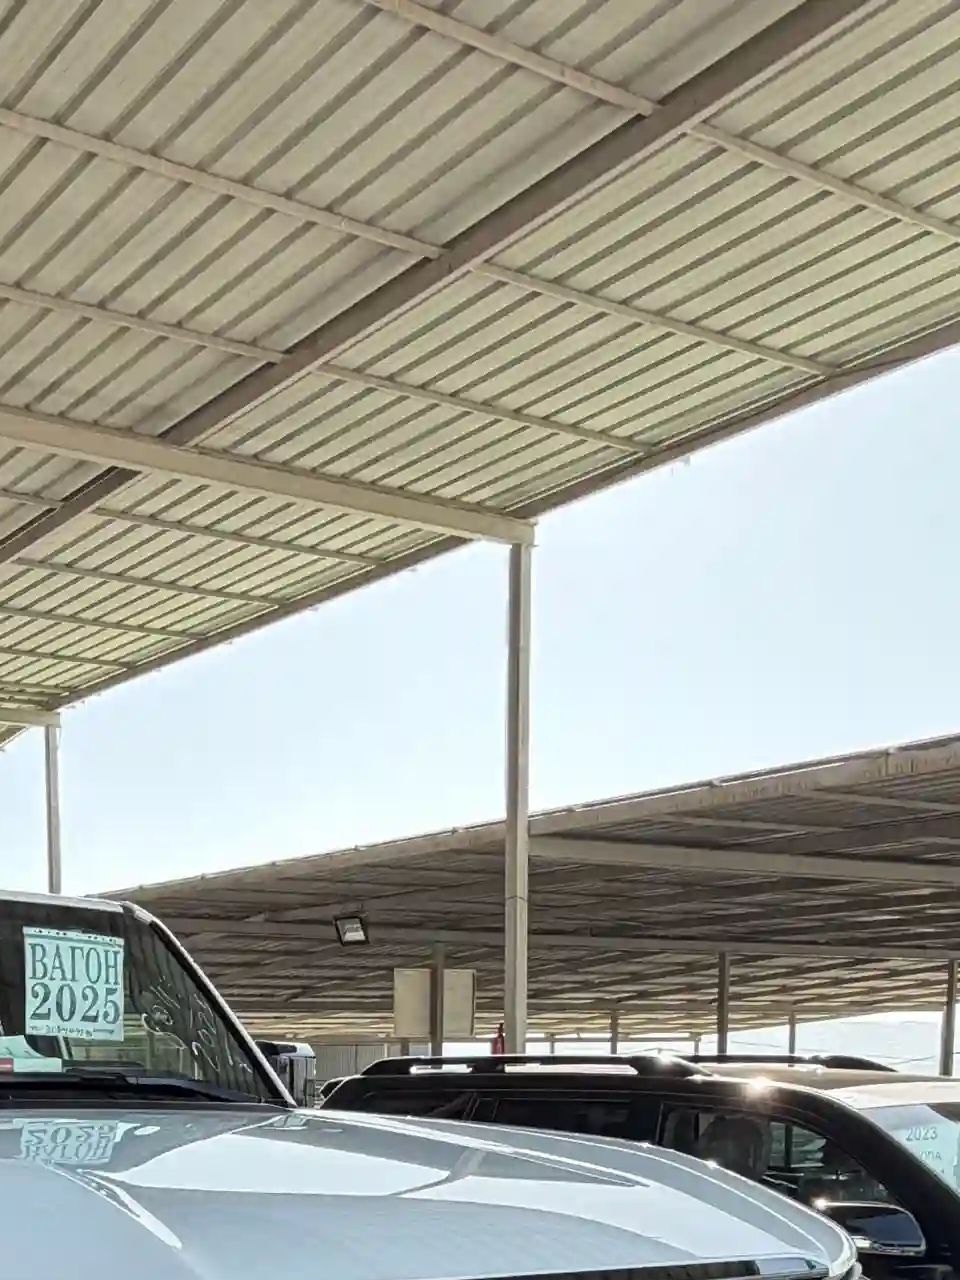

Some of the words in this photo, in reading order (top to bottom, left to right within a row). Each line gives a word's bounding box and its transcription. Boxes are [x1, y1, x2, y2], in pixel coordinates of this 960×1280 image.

[28, 943, 121, 986] ВАГОН
[30, 982, 121, 1024] 2025
[905, 1126, 938, 1142] 2023
